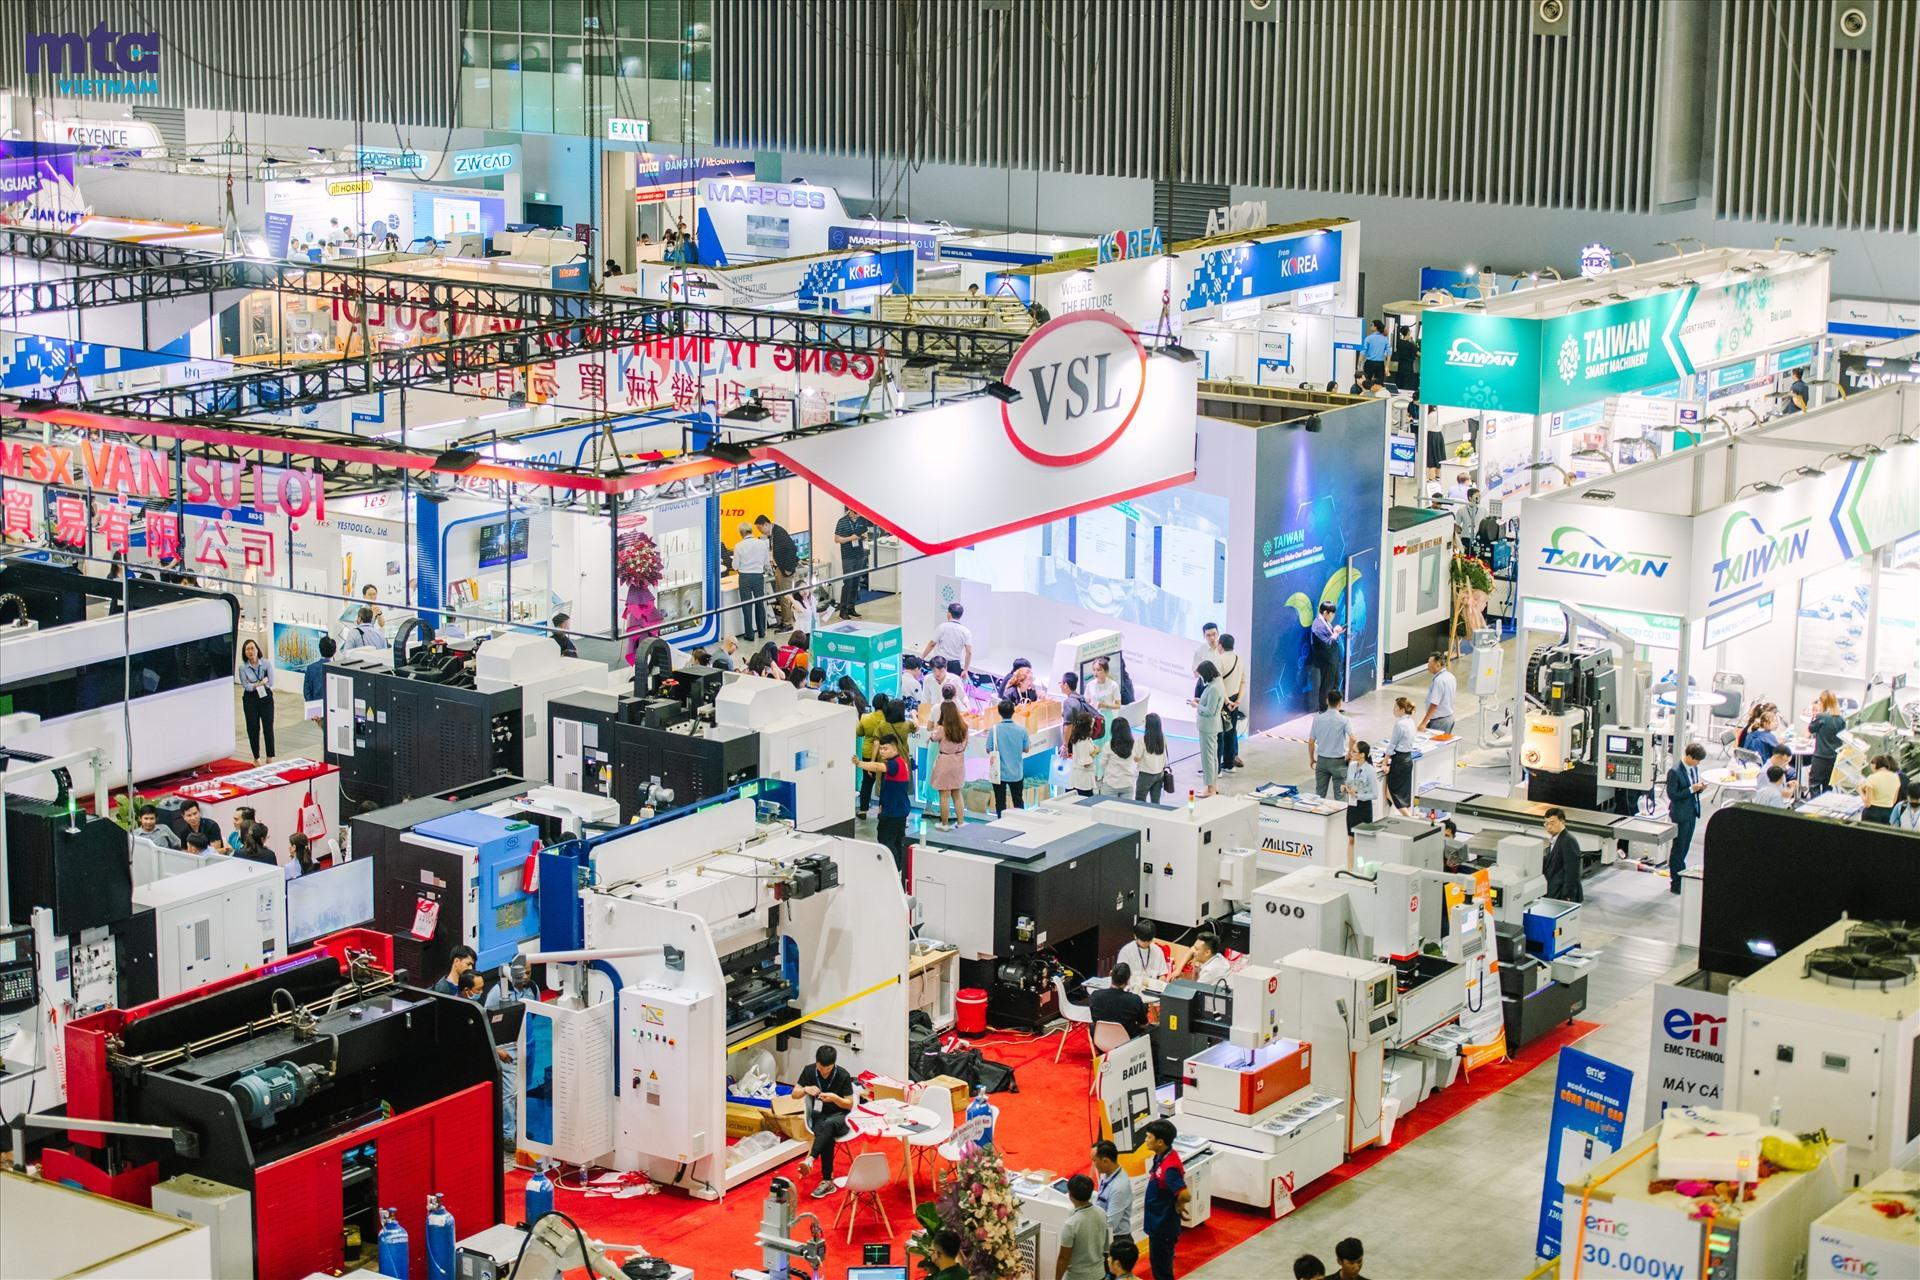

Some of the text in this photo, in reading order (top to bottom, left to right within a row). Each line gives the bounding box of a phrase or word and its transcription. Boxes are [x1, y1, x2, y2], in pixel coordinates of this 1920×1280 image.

[68, 127, 128, 146] KEYENCE
[611, 121, 645, 136] EXIT
[456, 154, 513, 173] ZWCAD
[340, 183, 361, 193] HORN
[708, 183, 826, 210] MARPOSS
[30, 208, 55, 221] JIAN
[1098, 226, 1165, 265] KOREA
[1278, 249, 1291, 260] from
[849, 263, 882, 281] KOREA
[1281, 254, 1318, 278] KOREA
[731, 273, 754, 284] WHERE
[1062, 278, 1093, 297] WHERE
[732, 295, 754, 306] BEGINS
[1080, 293, 1113, 311] FUTURE
[1584, 318, 1651, 363] TAIWAN
[1447, 345, 1519, 367] TAIWAN
[1585, 352, 1649, 380] SMART MACHINERY
[1029, 352, 1122, 425] VSL
[726, 508, 745, 517] LTD
[337, 520, 363, 533] YESTOOL
[1274, 529, 1305, 549] TAIWAN
[1540, 540, 1671, 578] TAIWAN
[1712, 526, 1810, 593] TAIWAN
[1664, 1043, 1684, 1056] EMC
[1122, 1060, 1148, 1081] BAVIA
[1586, 1066, 1607, 1081] emc
[1662, 1076, 1697, 1094] MÁY
[1583, 1214, 1630, 1237] emc
[1582, 1243, 1685, 1280] 30.000W
[1830, 1254, 1879, 1277] emc
